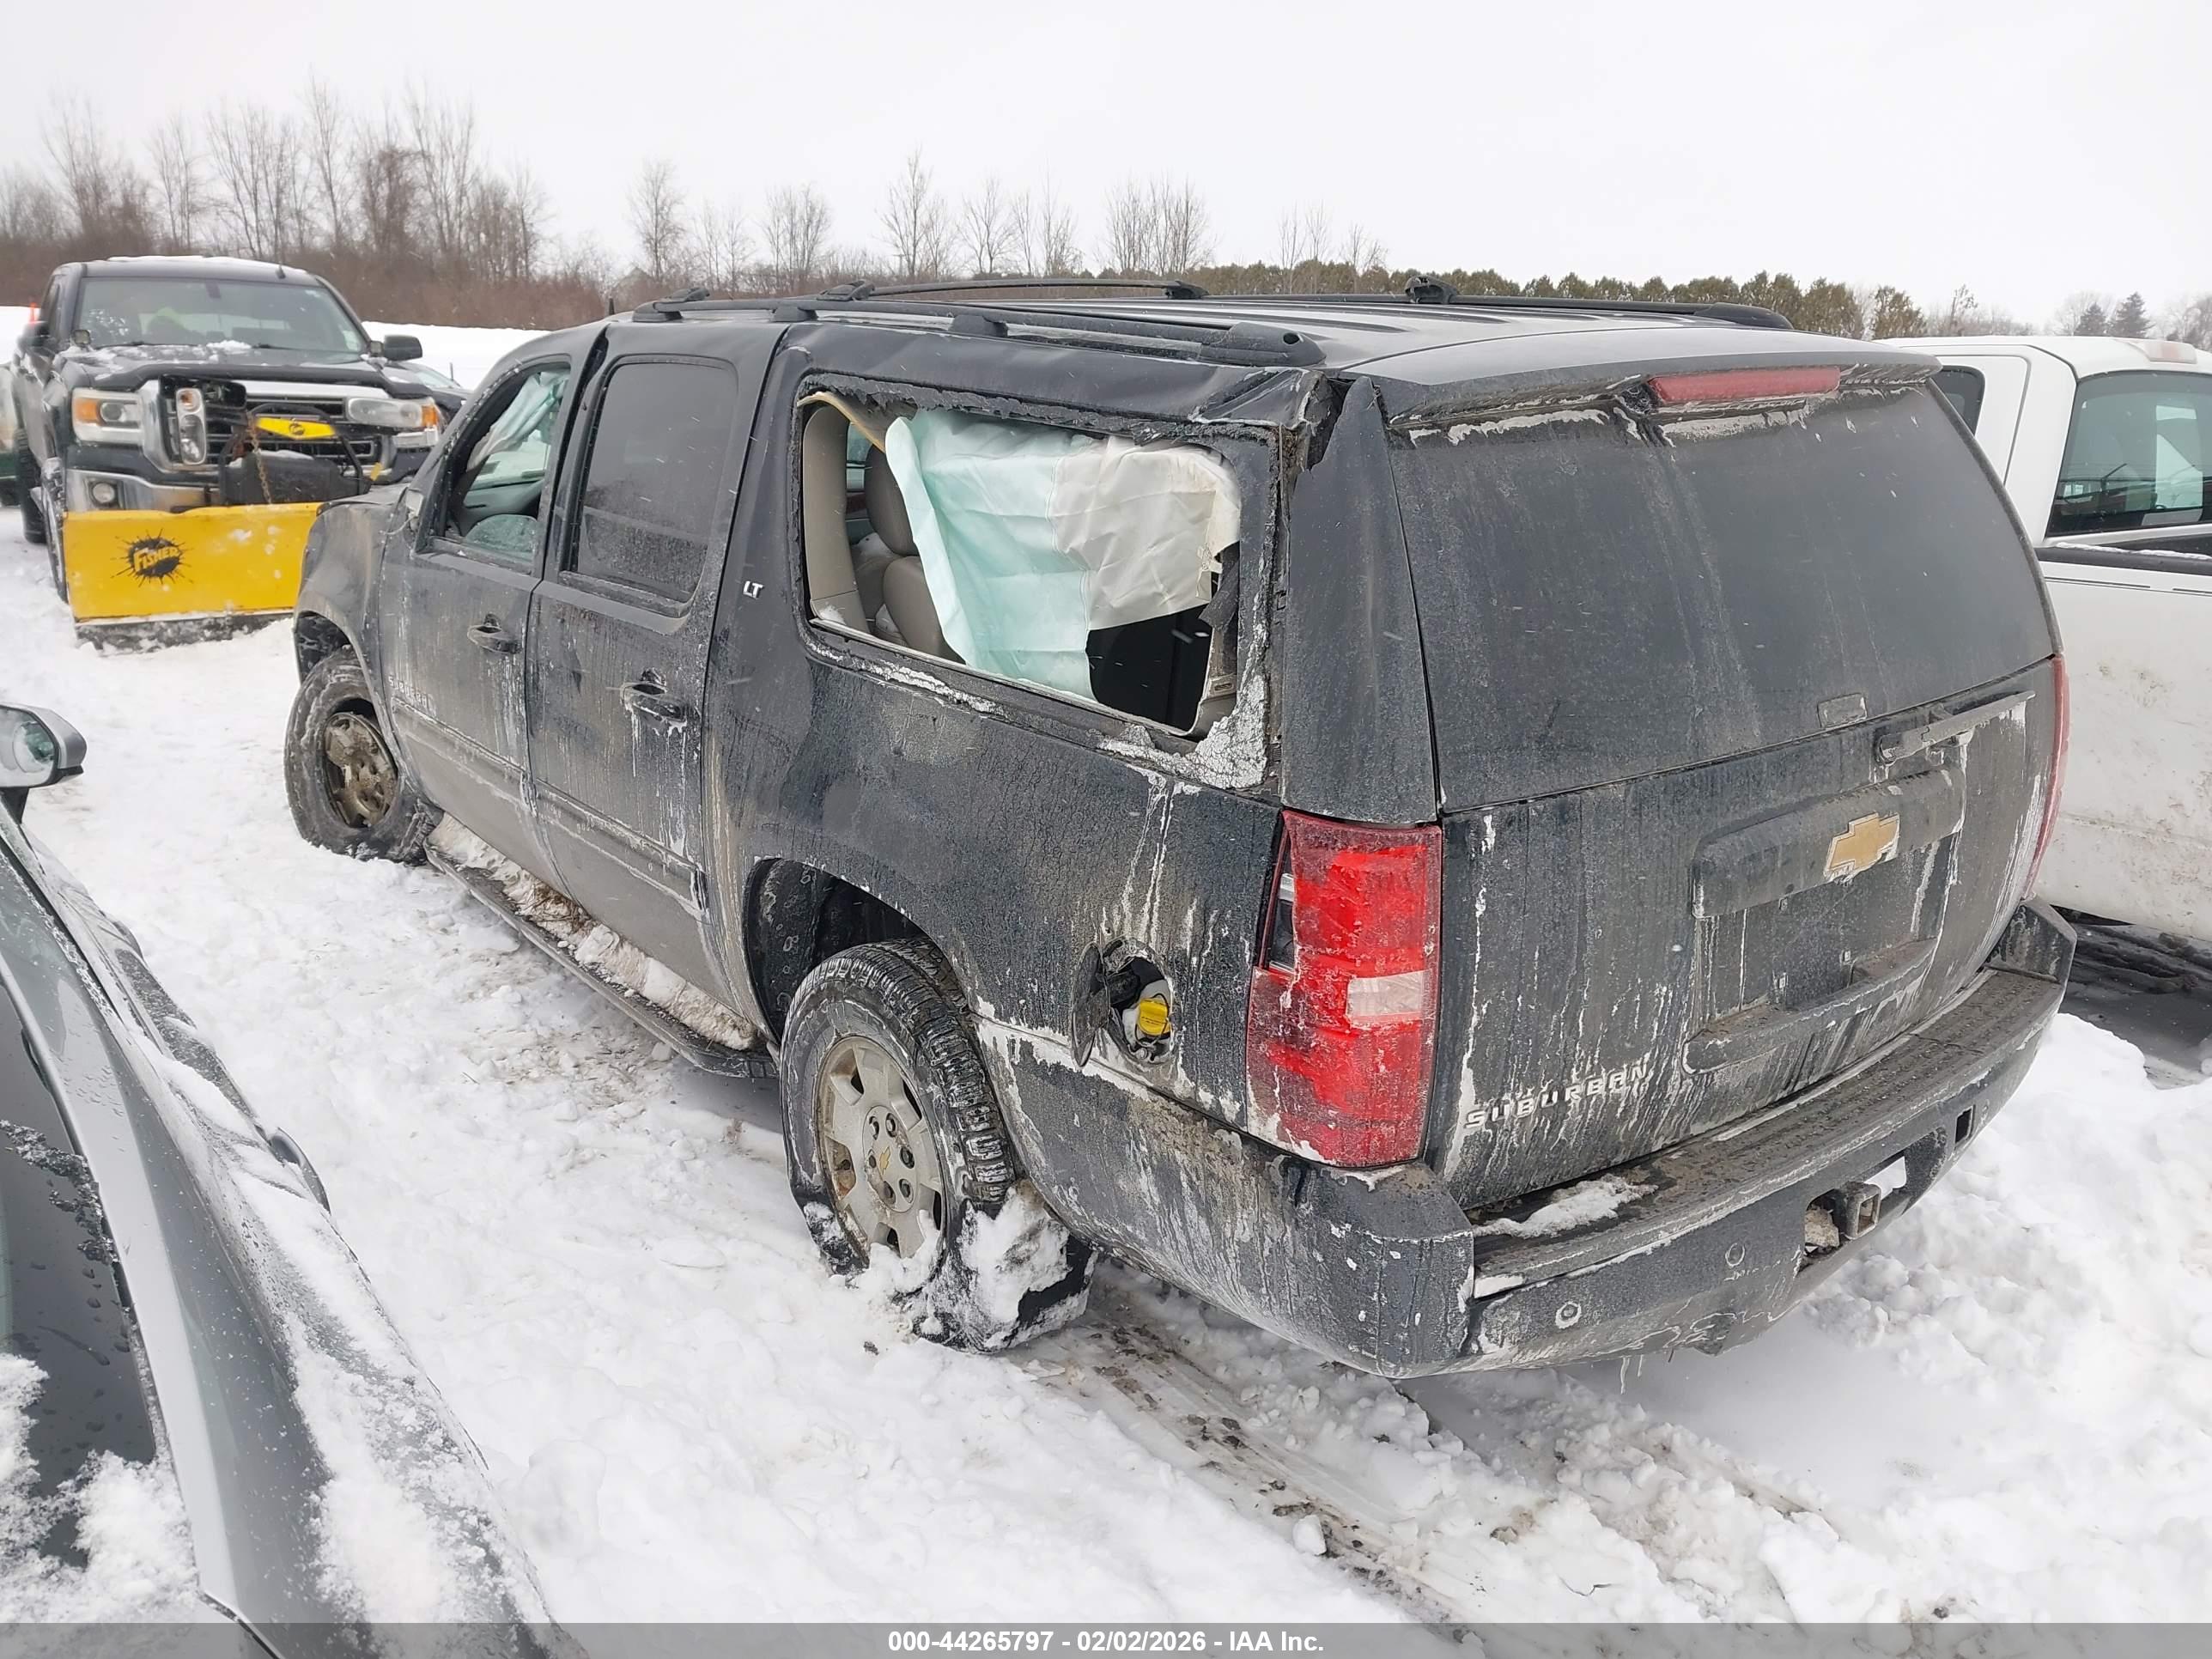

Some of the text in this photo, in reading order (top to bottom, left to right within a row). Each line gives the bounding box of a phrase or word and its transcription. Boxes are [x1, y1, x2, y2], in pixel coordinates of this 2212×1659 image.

[133, 546, 180, 572] FISHER
[743, 580, 763, 599] LT
[1463, 1062, 1649, 1129] SUBURBAN
